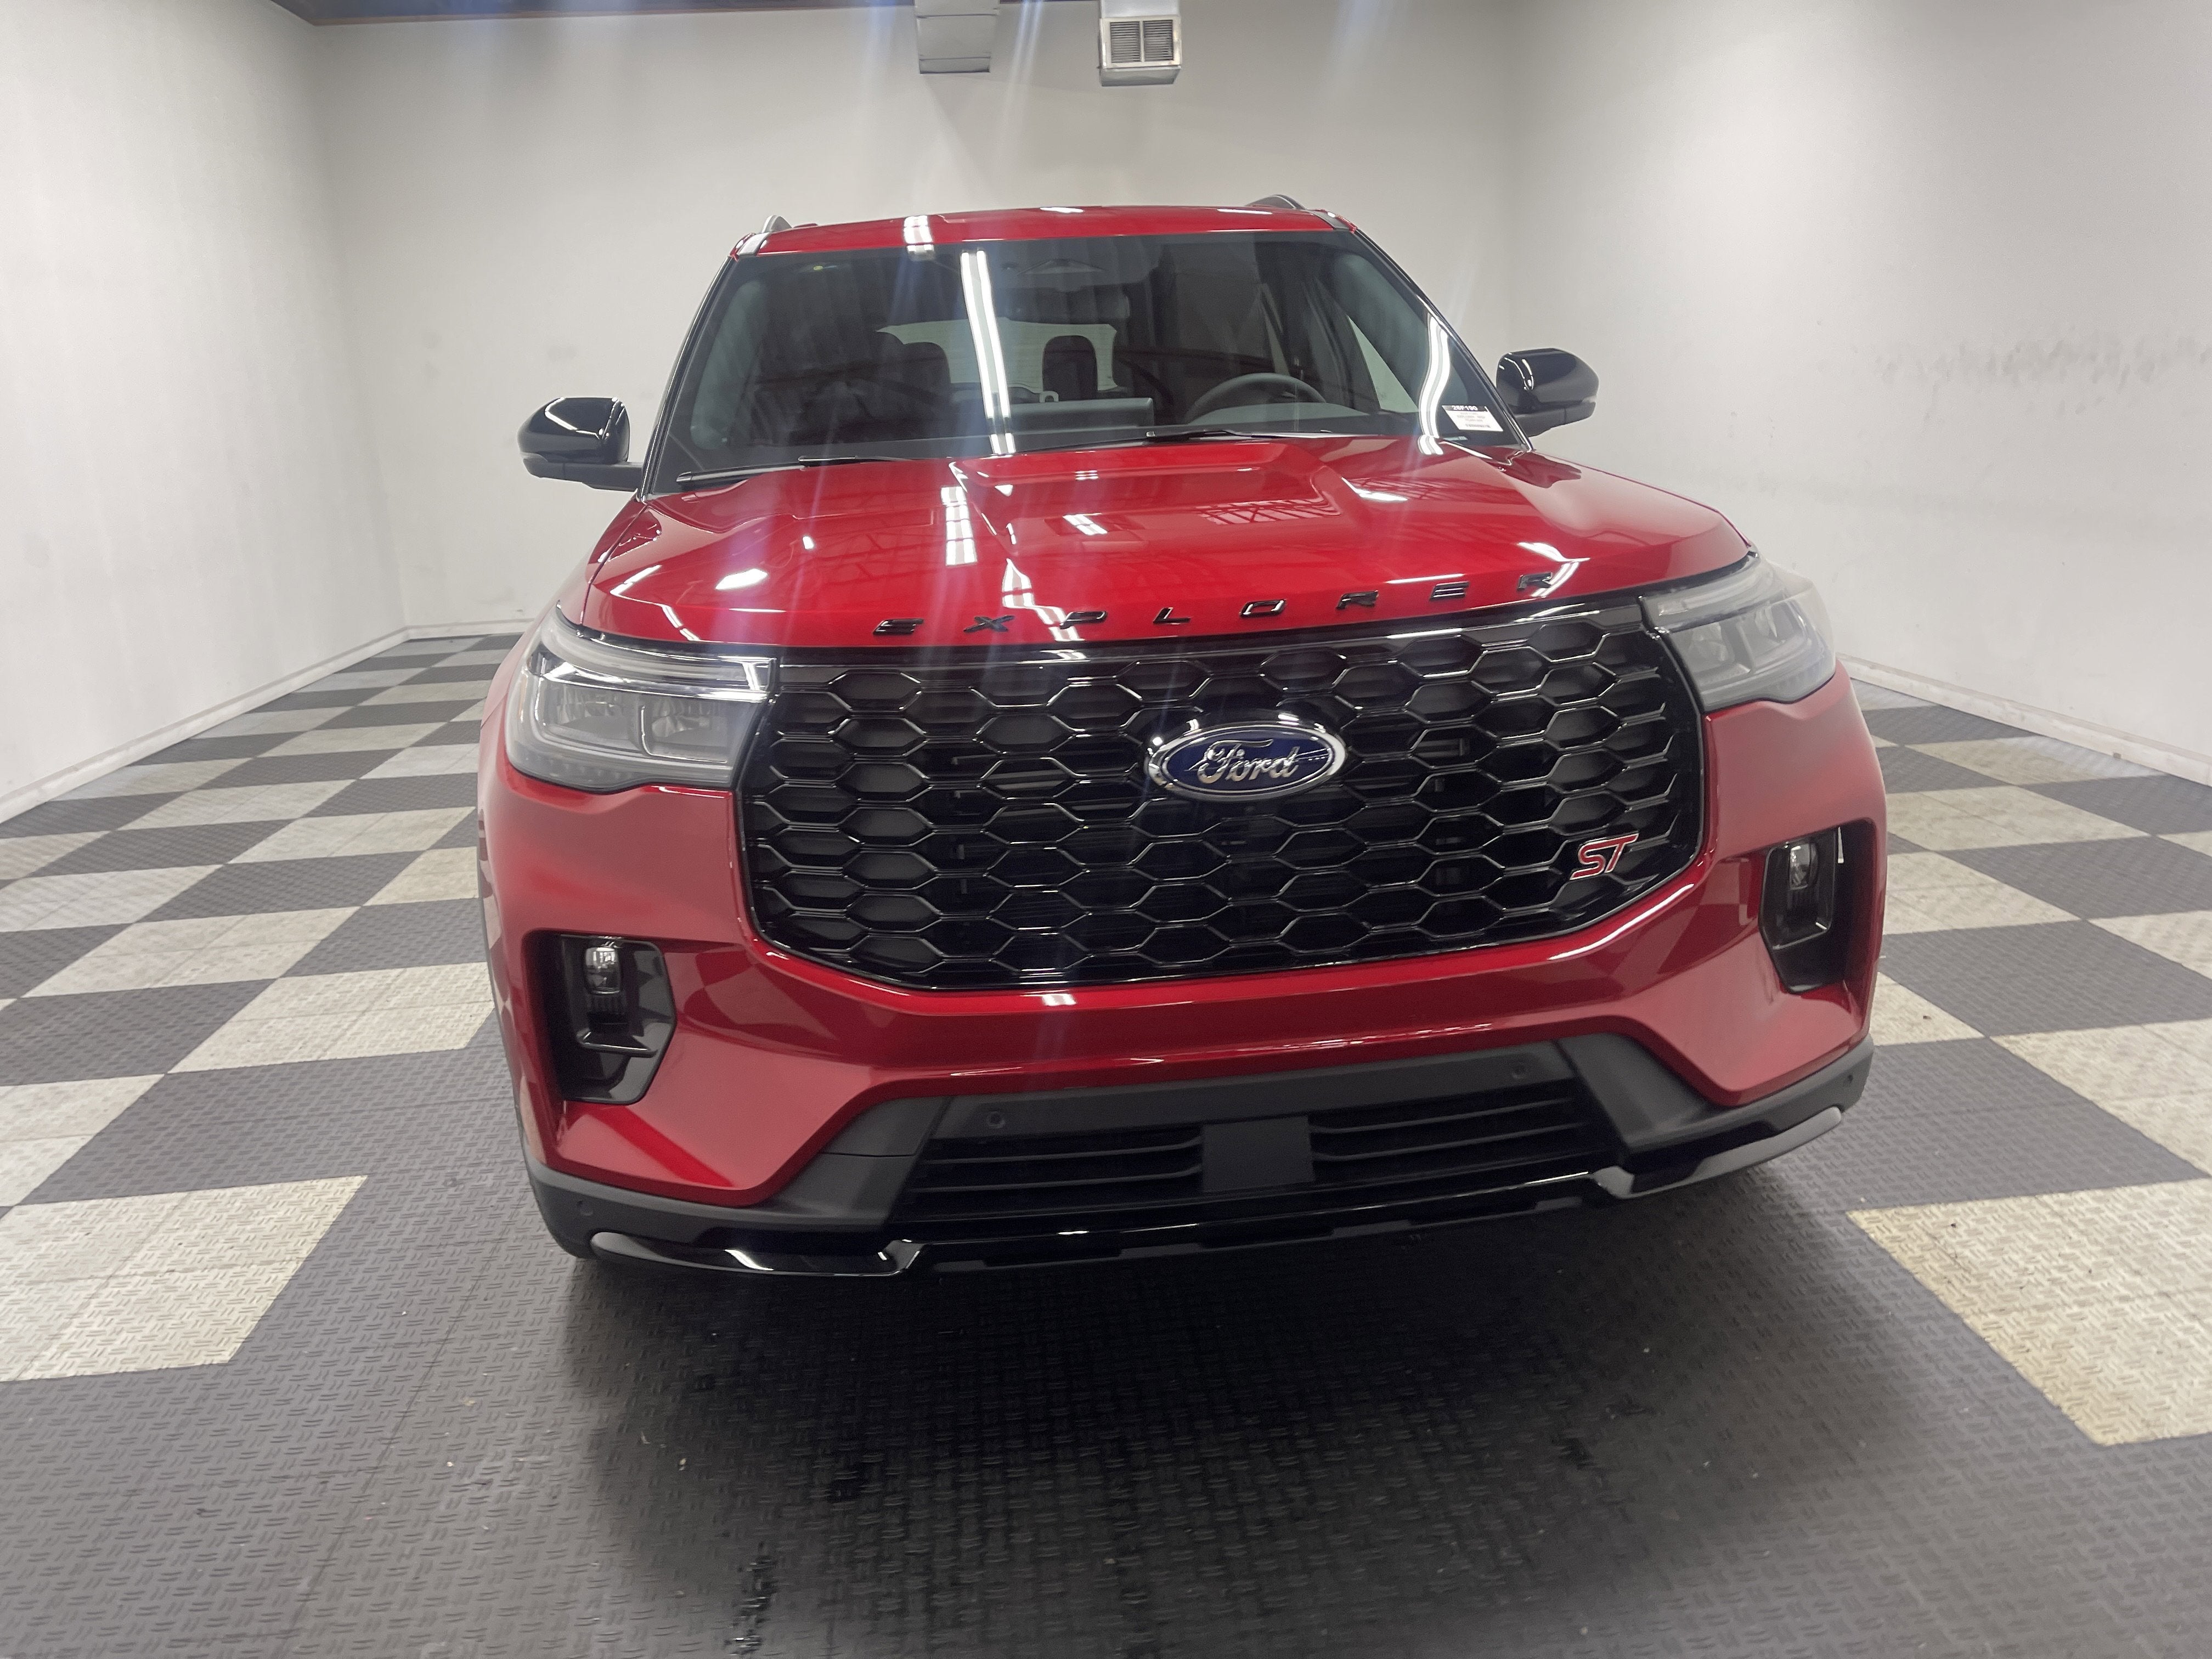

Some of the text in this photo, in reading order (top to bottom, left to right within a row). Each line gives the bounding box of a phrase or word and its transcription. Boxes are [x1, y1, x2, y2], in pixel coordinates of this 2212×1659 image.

[873, 572, 1553, 635] EXPLORER
[1186, 738, 1304, 785] Ford
[1569, 833, 1639, 881] ST
